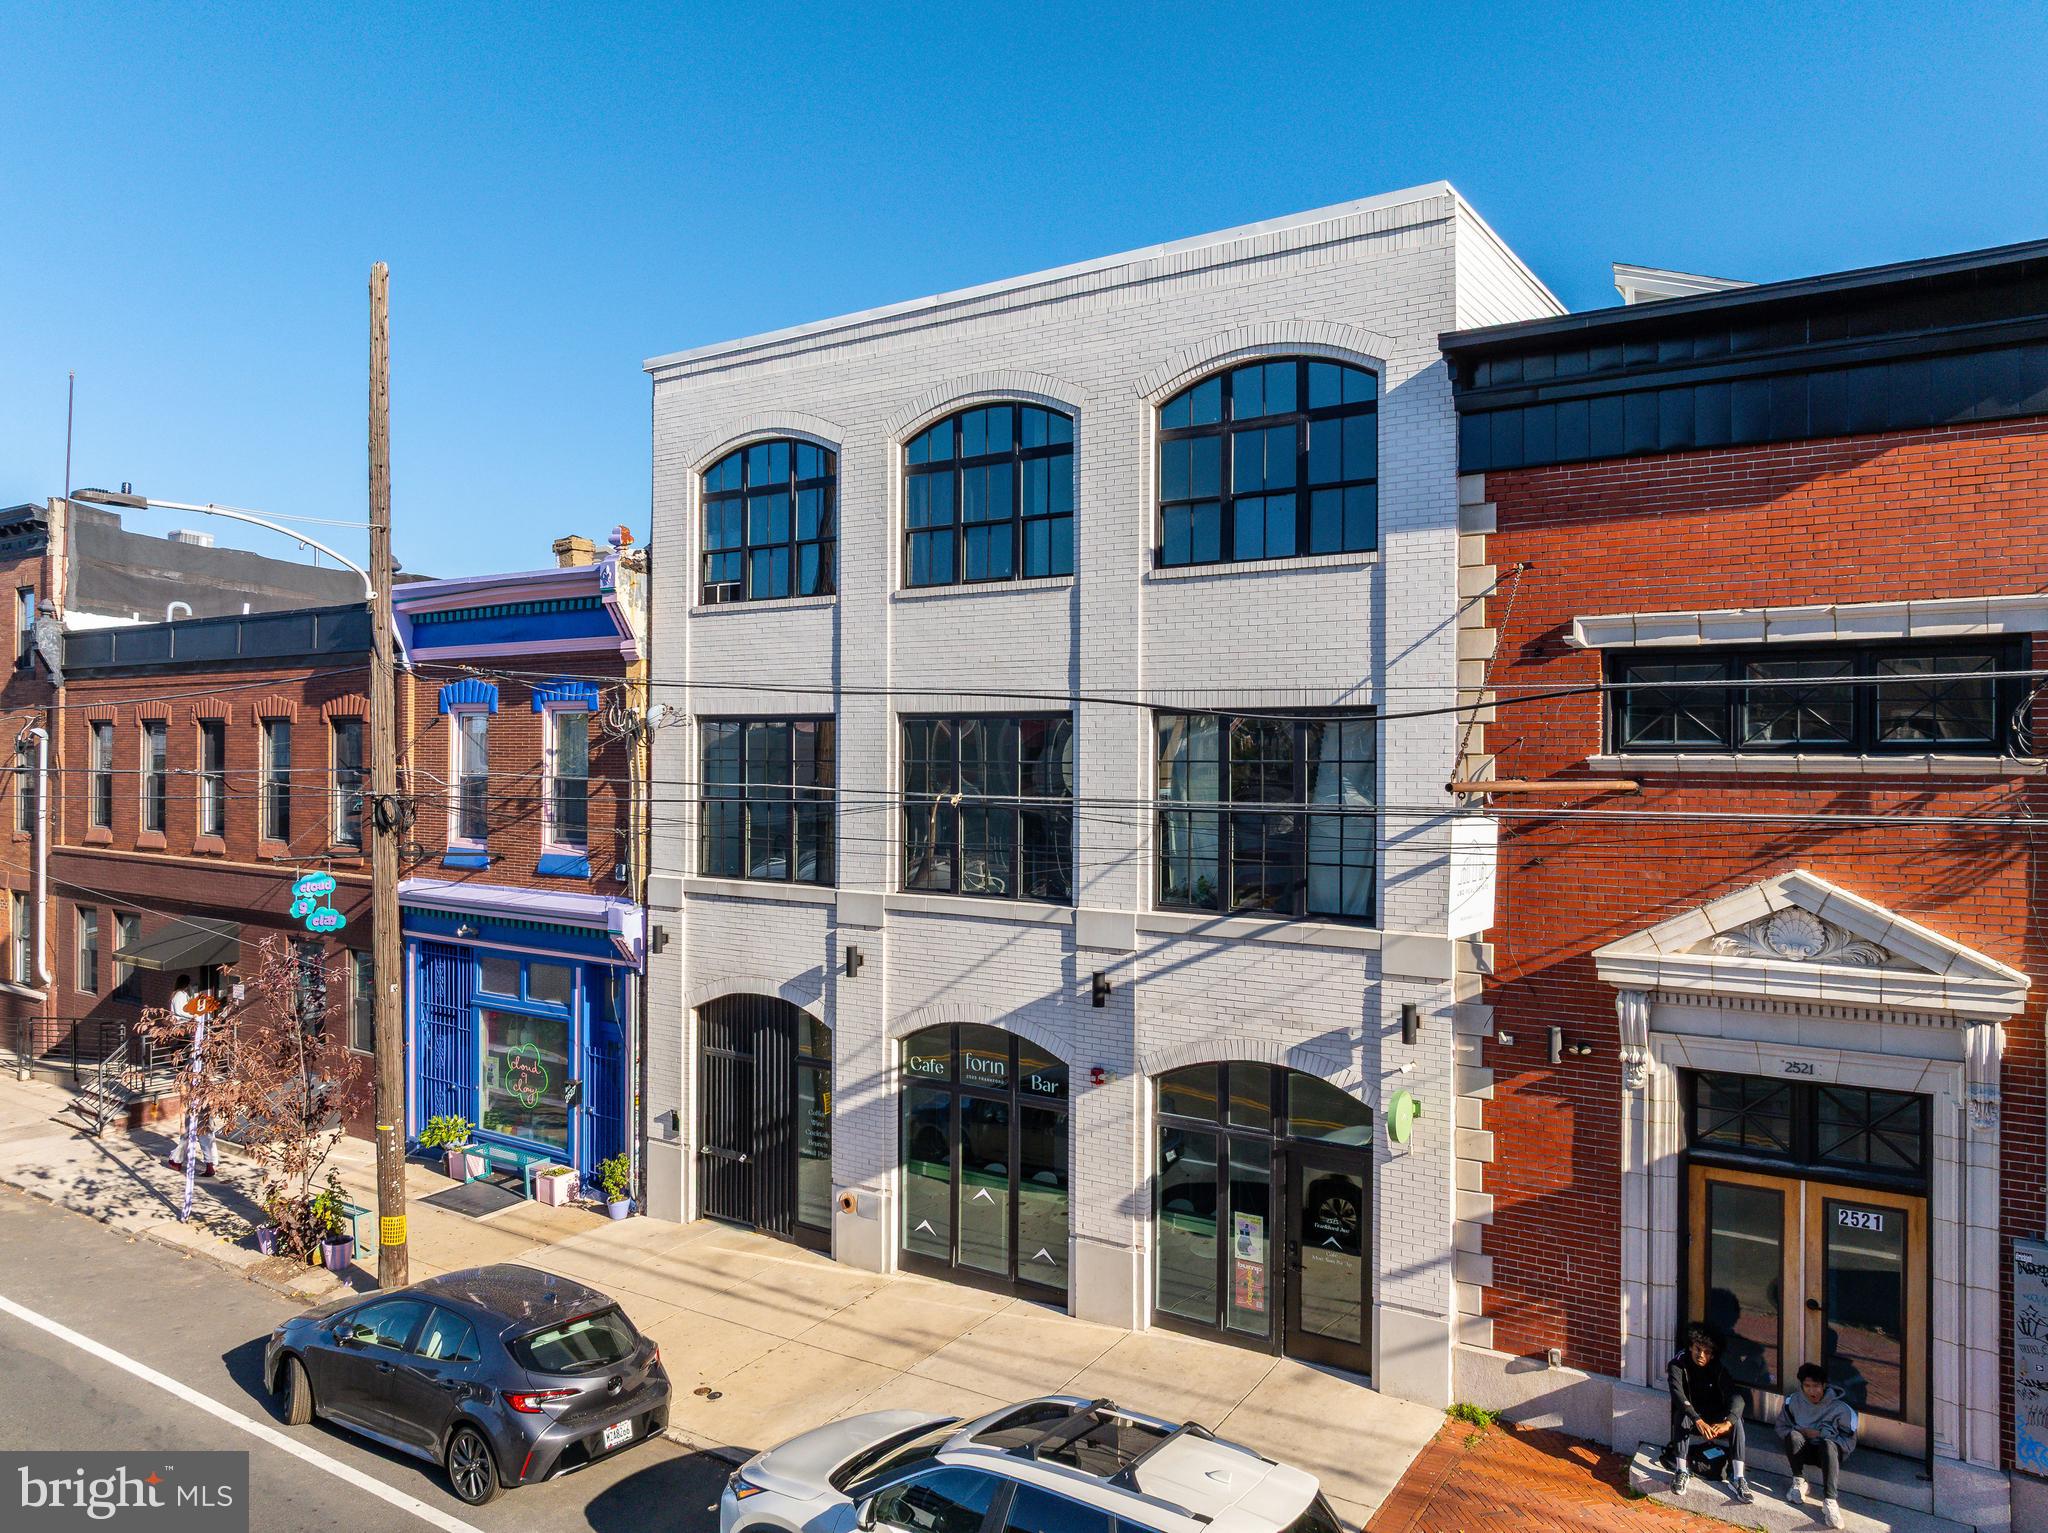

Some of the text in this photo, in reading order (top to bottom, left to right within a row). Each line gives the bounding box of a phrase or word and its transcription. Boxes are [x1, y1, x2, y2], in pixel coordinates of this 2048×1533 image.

[299, 880, 332, 893] cloud
[312, 914, 337, 926] clay
[510, 1055, 541, 1074] cloud
[1784, 1062, 1814, 1075] 2521
[910, 1052, 1059, 1094] Cafe forin Bar
[513, 1078, 537, 1104] clay
[1840, 1210, 1880, 1230] 2521
[1237, 1261, 1262, 1273] bump
